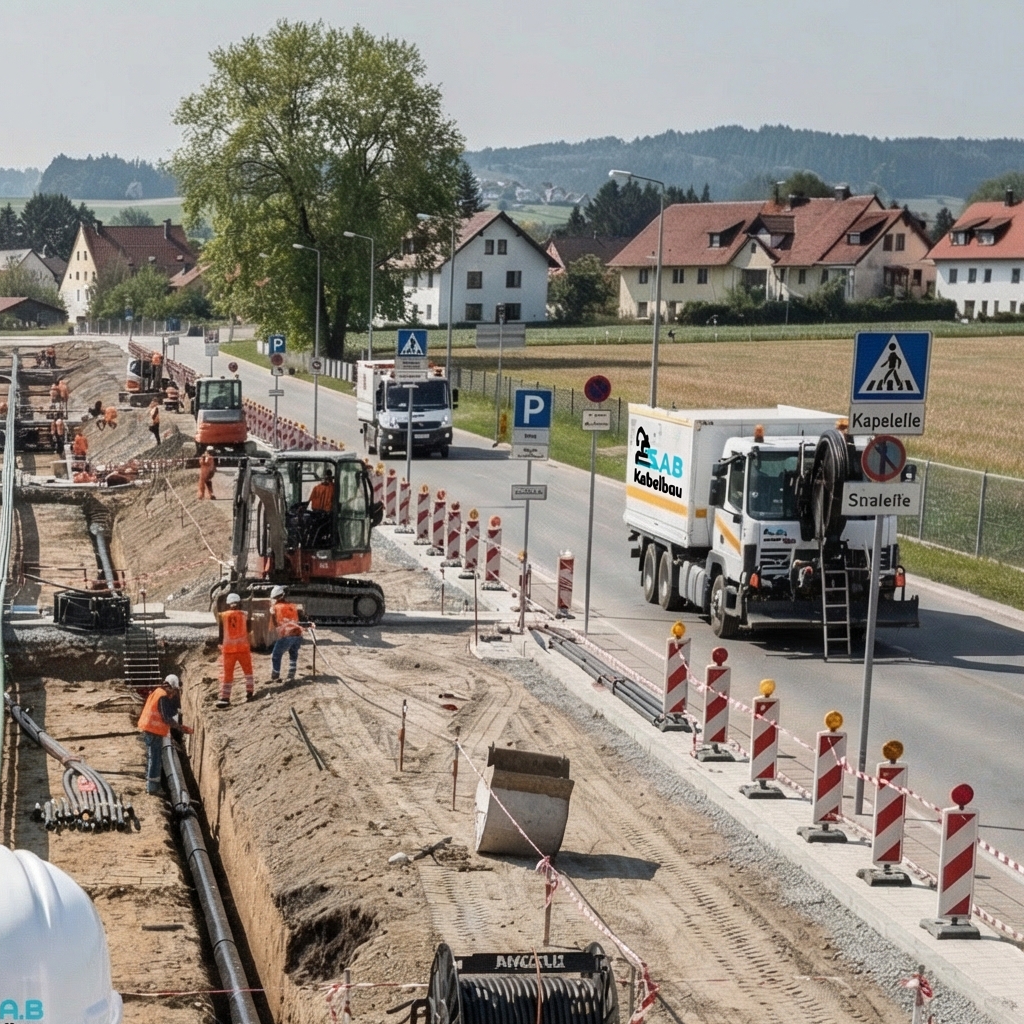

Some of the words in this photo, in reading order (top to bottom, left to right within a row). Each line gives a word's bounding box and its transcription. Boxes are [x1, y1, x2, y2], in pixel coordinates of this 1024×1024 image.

[273, 338, 283, 352] P
[523, 394, 545, 425] P
[633, 467, 683, 499] Kabelbau
